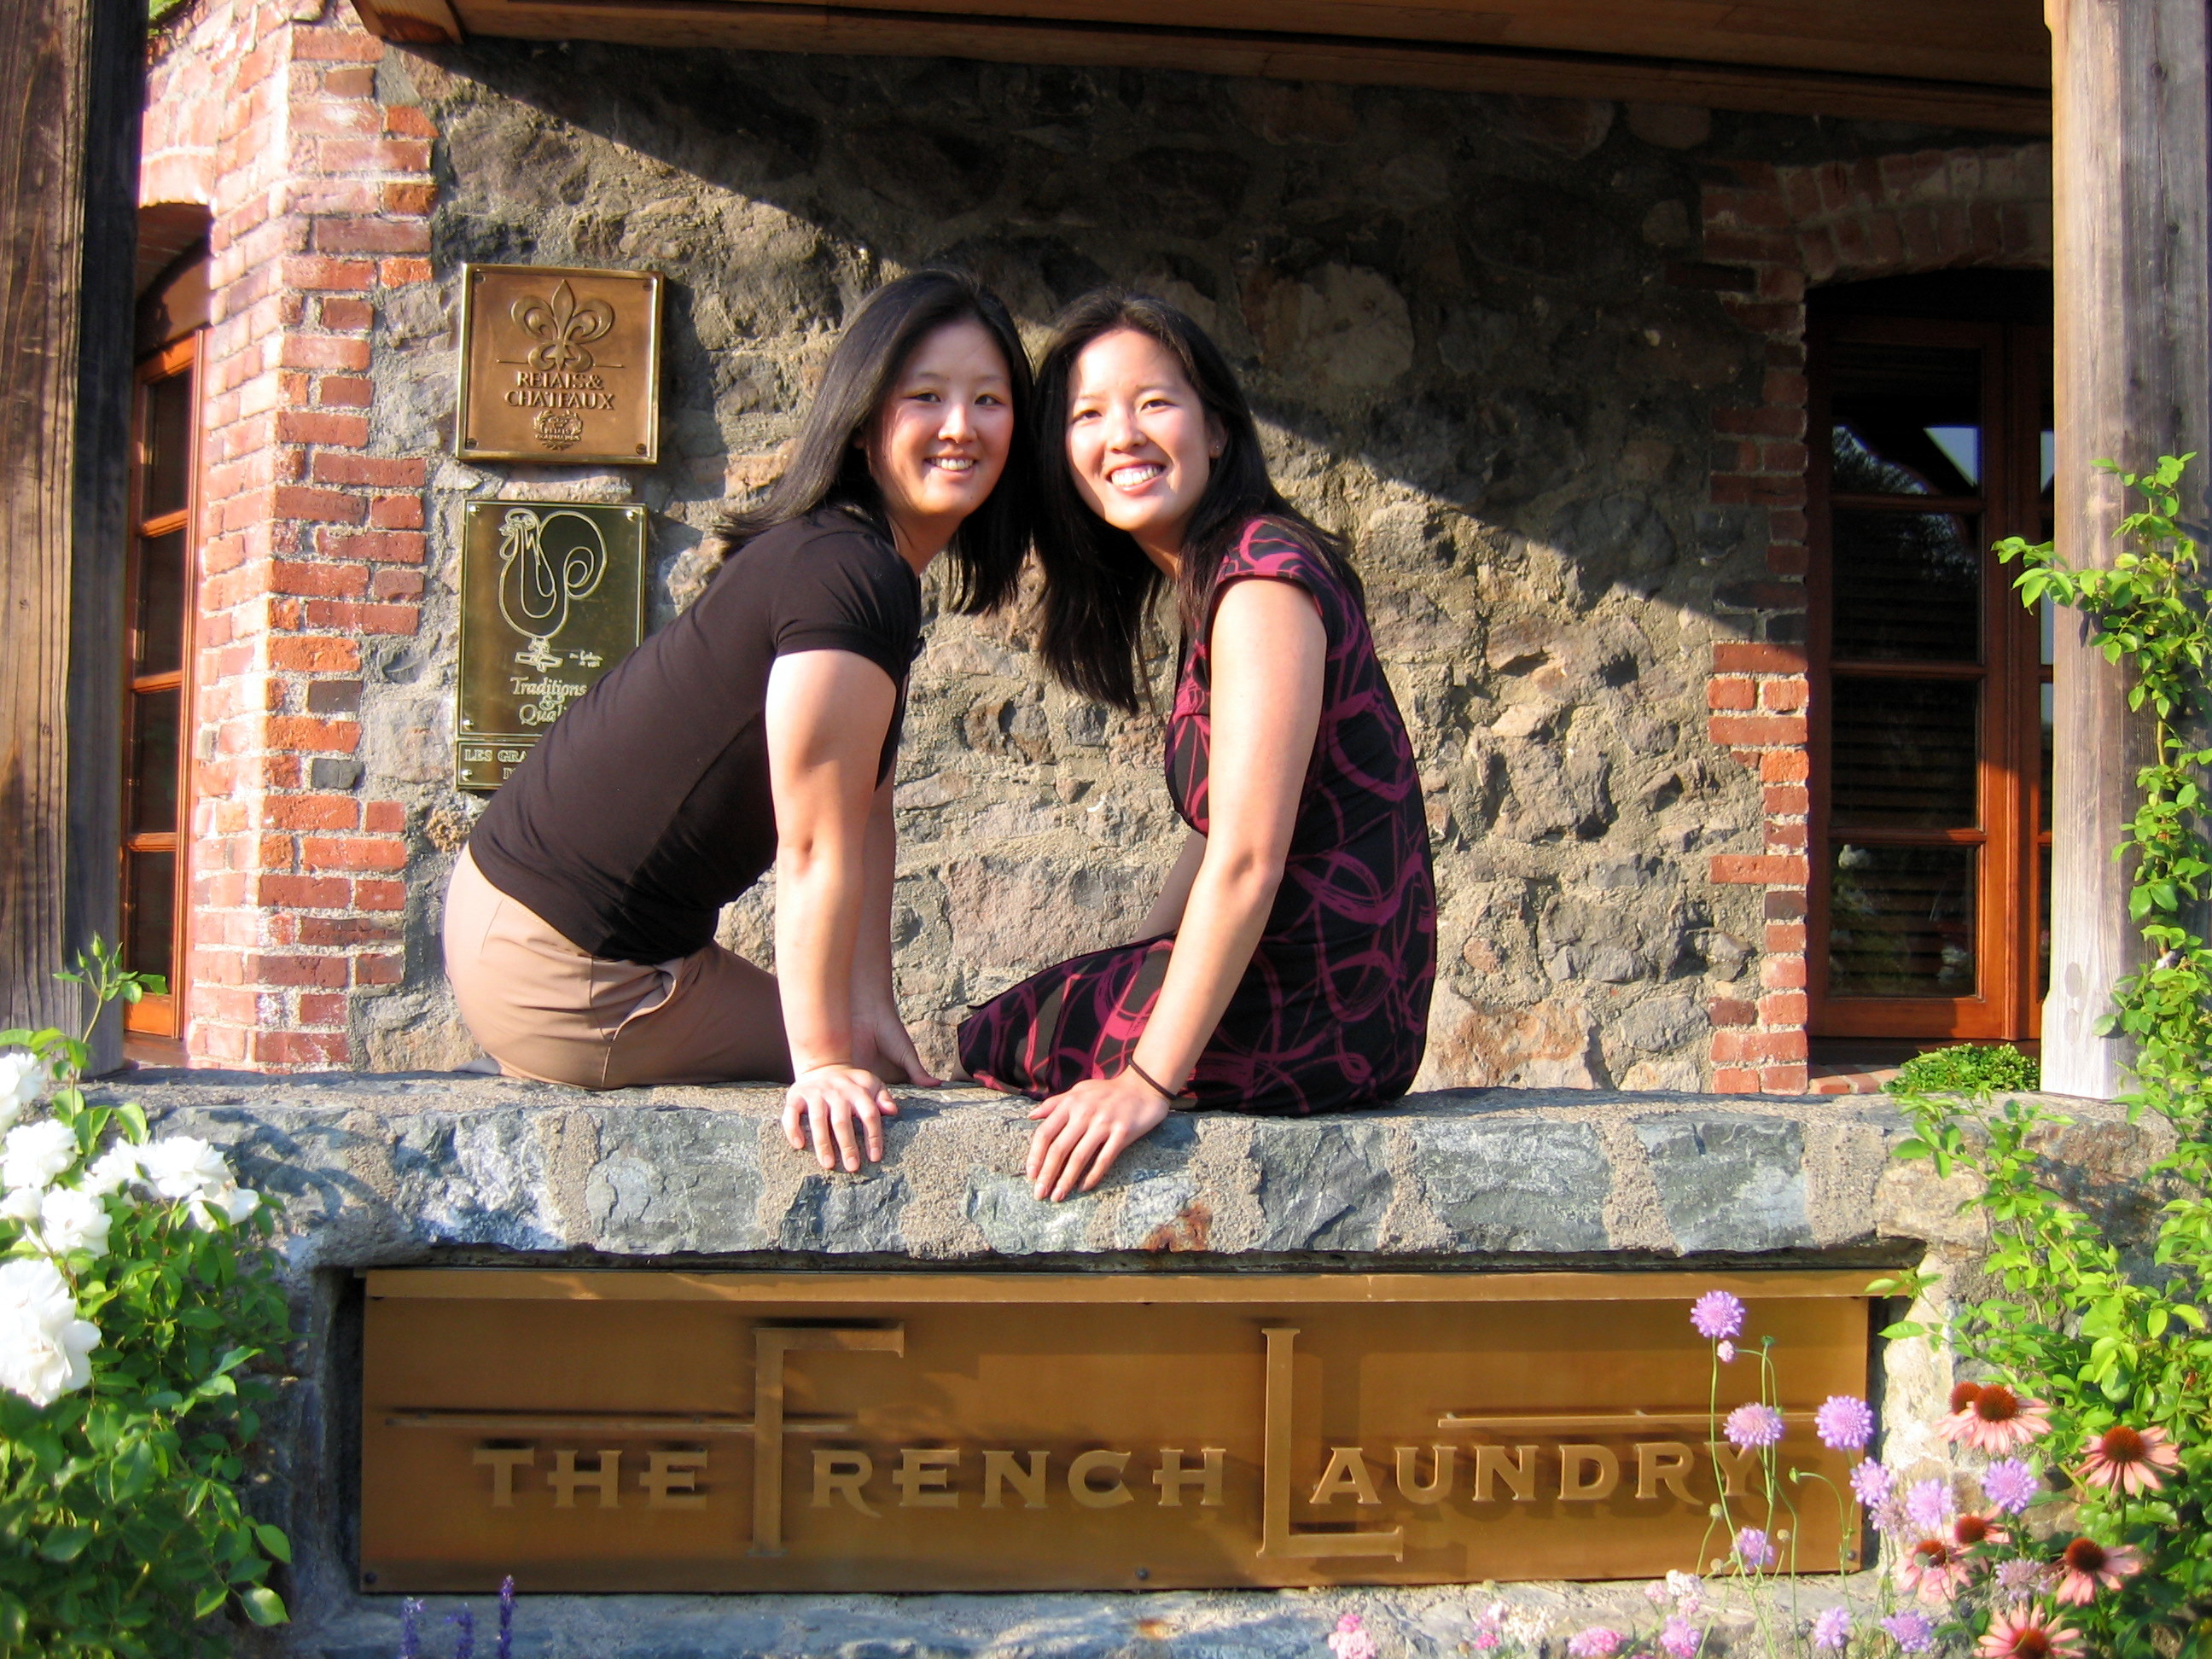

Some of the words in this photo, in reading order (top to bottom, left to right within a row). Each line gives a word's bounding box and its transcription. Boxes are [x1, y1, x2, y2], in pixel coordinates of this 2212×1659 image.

[504, 390, 615, 410] CHATEAUX
[509, 676, 588, 696] Traditions
[538, 692, 565, 711] &
[519, 703, 568, 726] Qual
[463, 748, 492, 762] LES
[472, 1447, 709, 1510] THE
[747, 1321, 1226, 1558] FRENCH
[1256, 1326, 1760, 1563] LAUNDRY
